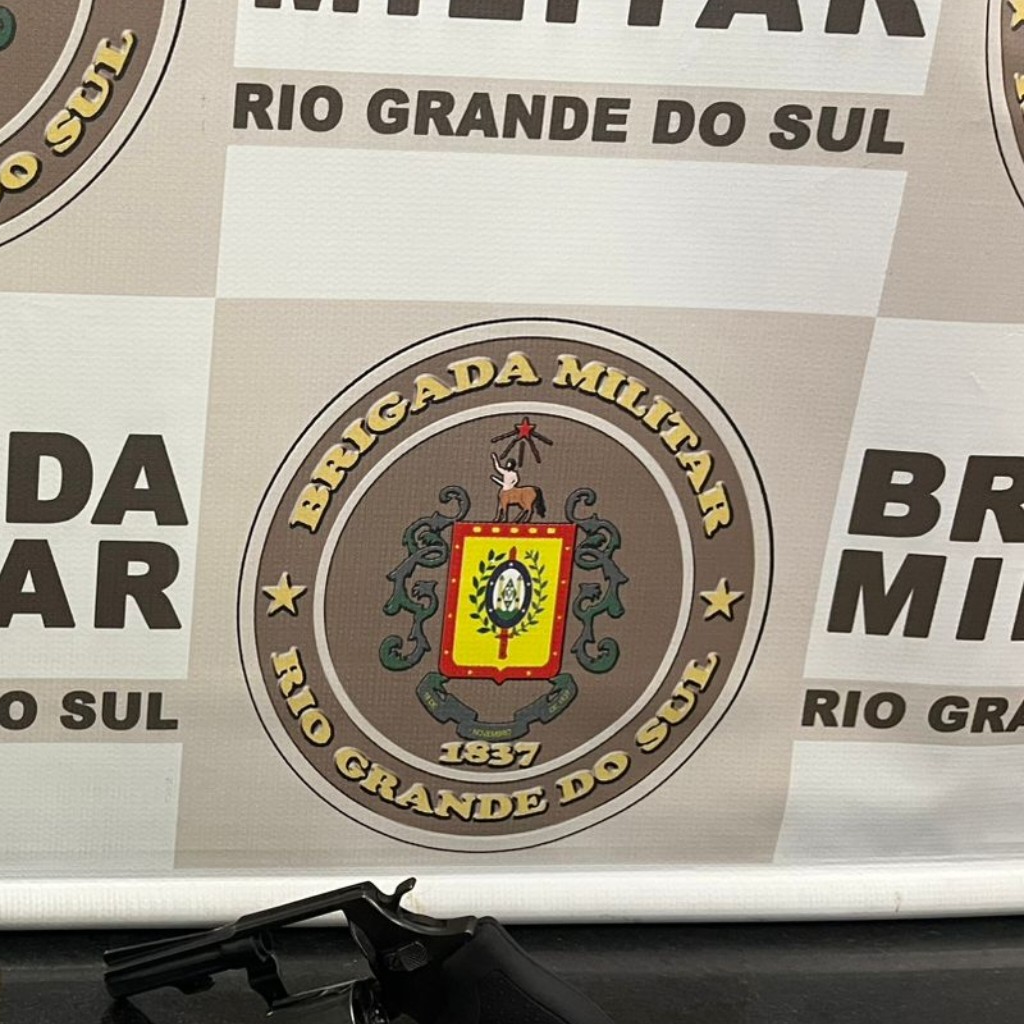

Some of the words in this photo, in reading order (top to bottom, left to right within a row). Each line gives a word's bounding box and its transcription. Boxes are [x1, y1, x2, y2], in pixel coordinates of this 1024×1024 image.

[44, 29, 138, 155] SUL
[234, 83, 343, 131] RIO
[367, 89, 630, 142] GRANDE
[653, 100, 745, 146] DO
[770, 105, 904, 154] SUL
[288, 350, 542, 533] BRIGADA
[552, 353, 734, 538] MILITAR
[848, 449, 1024, 543] BR
[827, 550, 1024, 641] MI
[60, 691, 178, 730] SUL
[270, 646, 334, 748] RIO
[332, 746, 550, 821] GRANDE
[559, 750, 632, 806] DO
[635, 651, 721, 755] SUL
[438, 740, 542, 769] 1837
[802, 689, 906, 729] RIO
